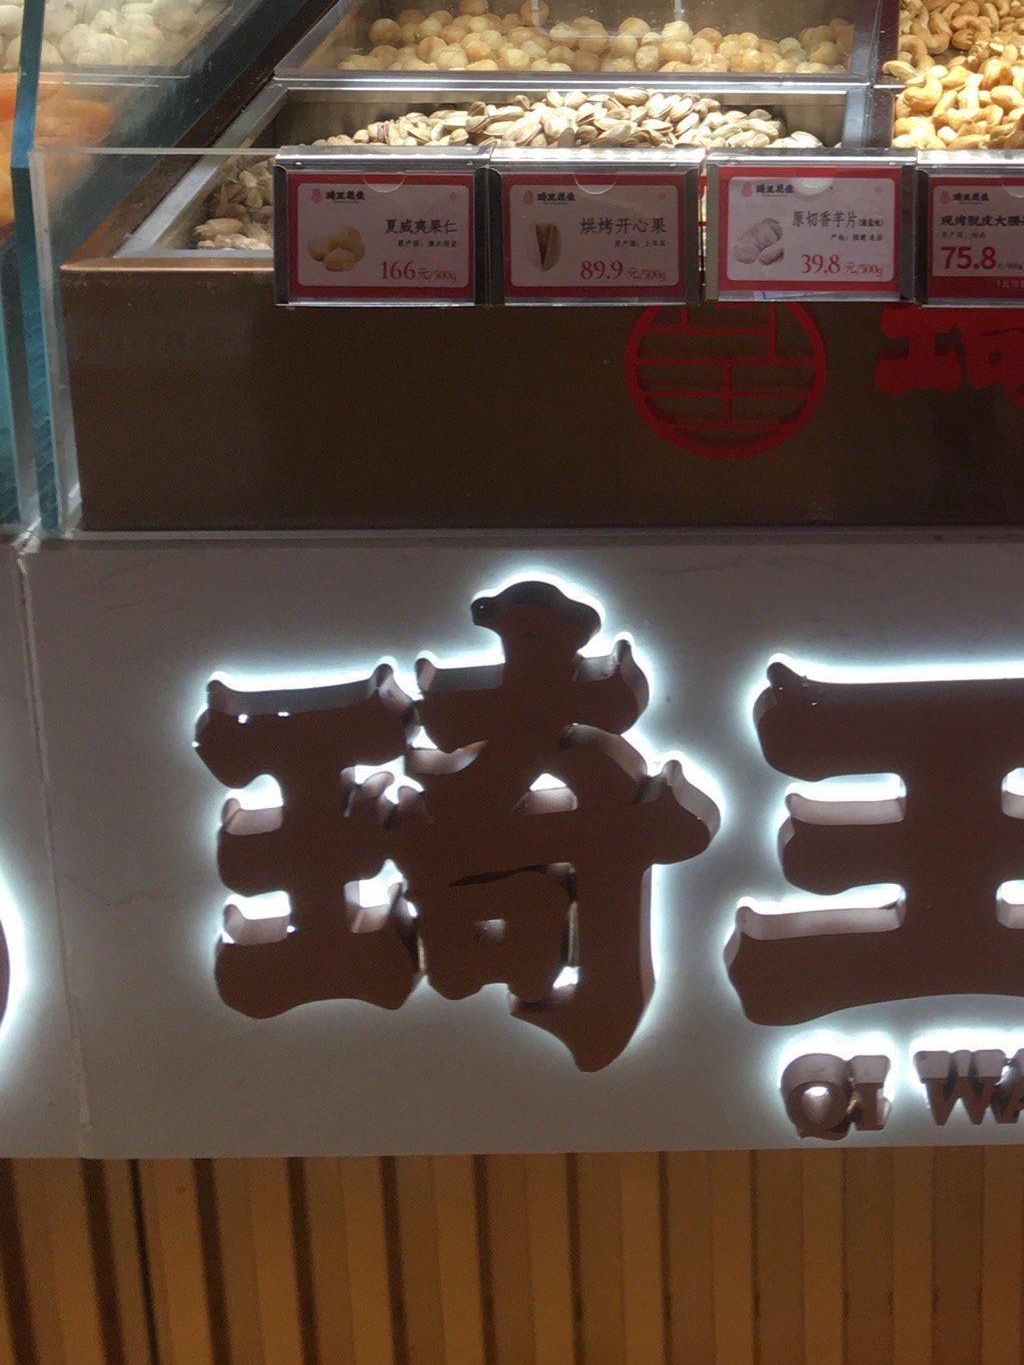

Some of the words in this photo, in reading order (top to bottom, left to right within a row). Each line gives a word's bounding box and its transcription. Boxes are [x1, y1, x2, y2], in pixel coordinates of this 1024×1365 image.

[580, 217, 667, 235] 烘烤开心果
[802, 254, 841, 274] 39.8
[941, 246, 997, 270] 75.8
[381, 260, 416, 280] 166
[580, 260, 624, 280] 89.9
[780, 1053, 890, 1140] QI
